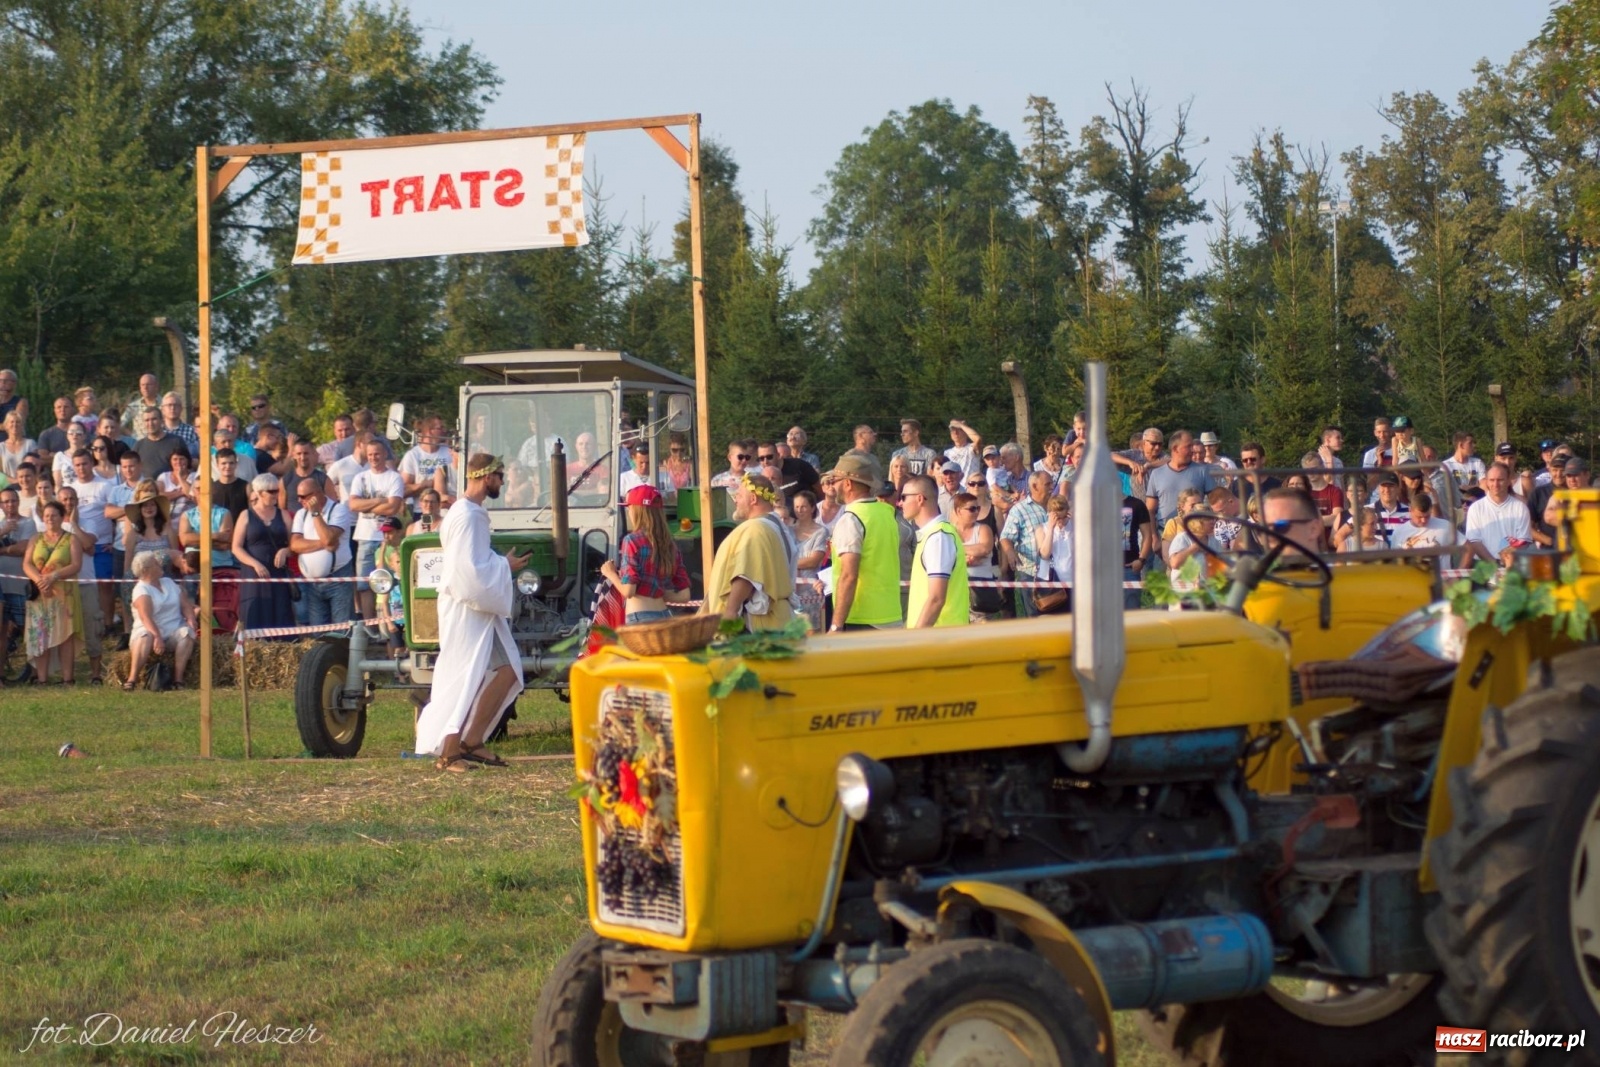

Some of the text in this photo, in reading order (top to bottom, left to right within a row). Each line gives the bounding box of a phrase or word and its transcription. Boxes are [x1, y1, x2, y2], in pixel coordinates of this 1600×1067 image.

[431, 575, 441, 583] 19
[809, 701, 977, 732] SAFETY TRAKTOR
